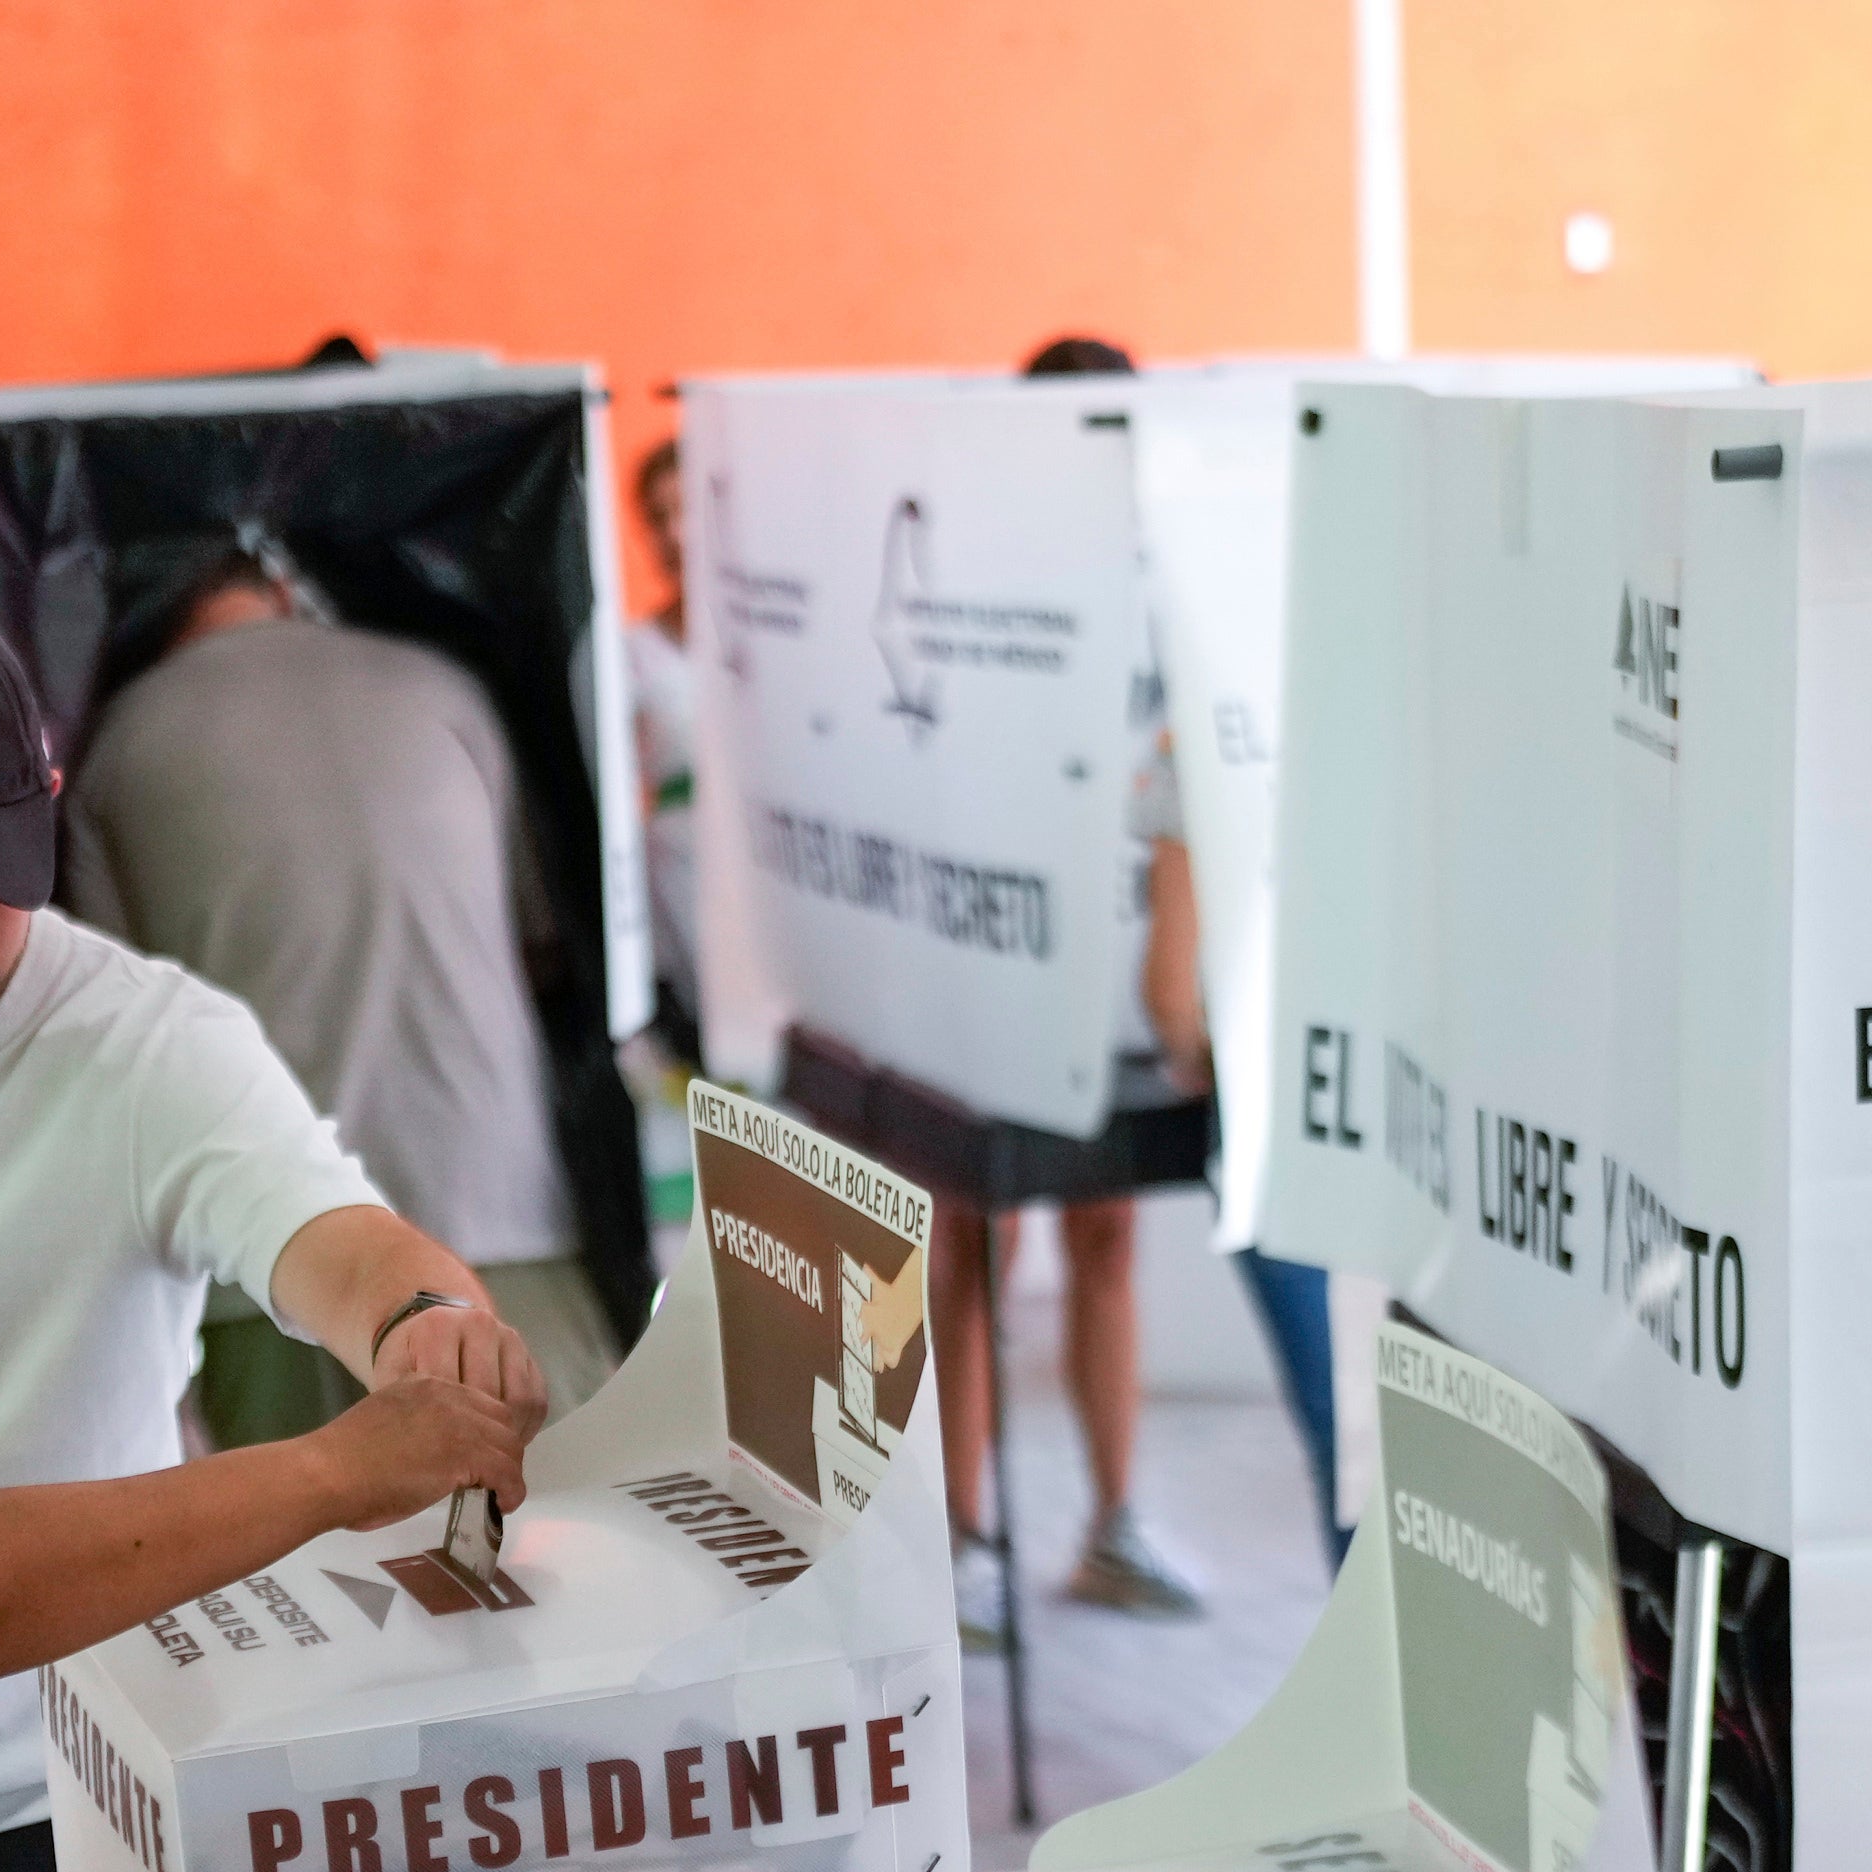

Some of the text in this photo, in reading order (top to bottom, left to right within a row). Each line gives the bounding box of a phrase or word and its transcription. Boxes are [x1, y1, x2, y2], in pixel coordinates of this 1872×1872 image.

[693, 1090, 926, 1242] META AQUÍ SOLO LA BOLETA DE
[1302, 1024, 1363, 1150] EL
[1476, 1107, 1578, 1276] LIBRE
[1601, 1155, 1618, 1296] Y
[711, 1209, 823, 1314] PRESIDENCIA
[1378, 1336, 1435, 1397] META
[1394, 1489, 1548, 1627] SENADURÍAS
[145, 1614, 205, 1668] OLETA
[226, 1625, 266, 1652] SU
[242, 1575, 331, 1647] DEPOSITE
